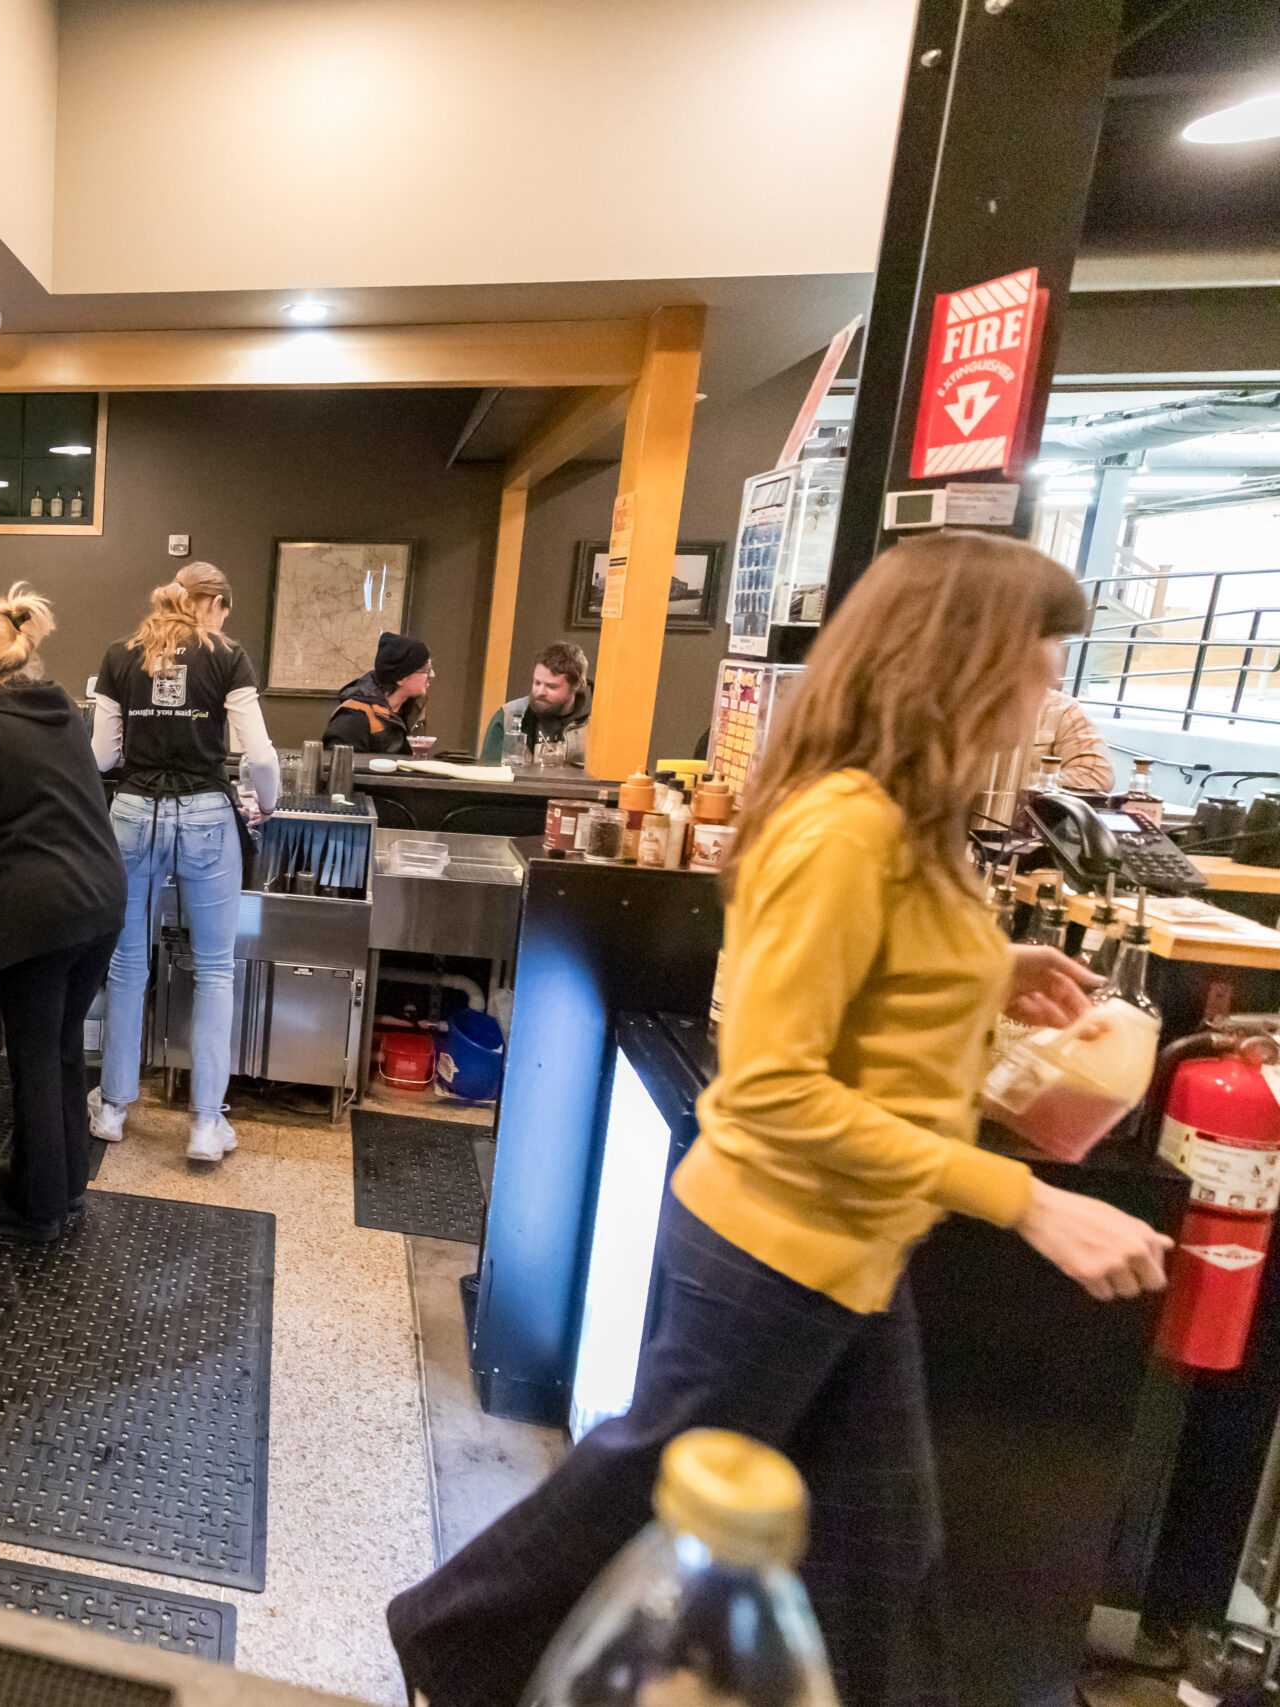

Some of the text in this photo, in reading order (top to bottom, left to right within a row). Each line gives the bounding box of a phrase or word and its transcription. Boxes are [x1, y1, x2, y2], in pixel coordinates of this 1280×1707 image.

[941, 308, 1024, 364] FIRE
[937, 358, 1016, 397] EXTINGUISHER
[128, 709, 155, 717] hought
[156, 709, 173, 717] you
[174, 709, 192, 717] said
